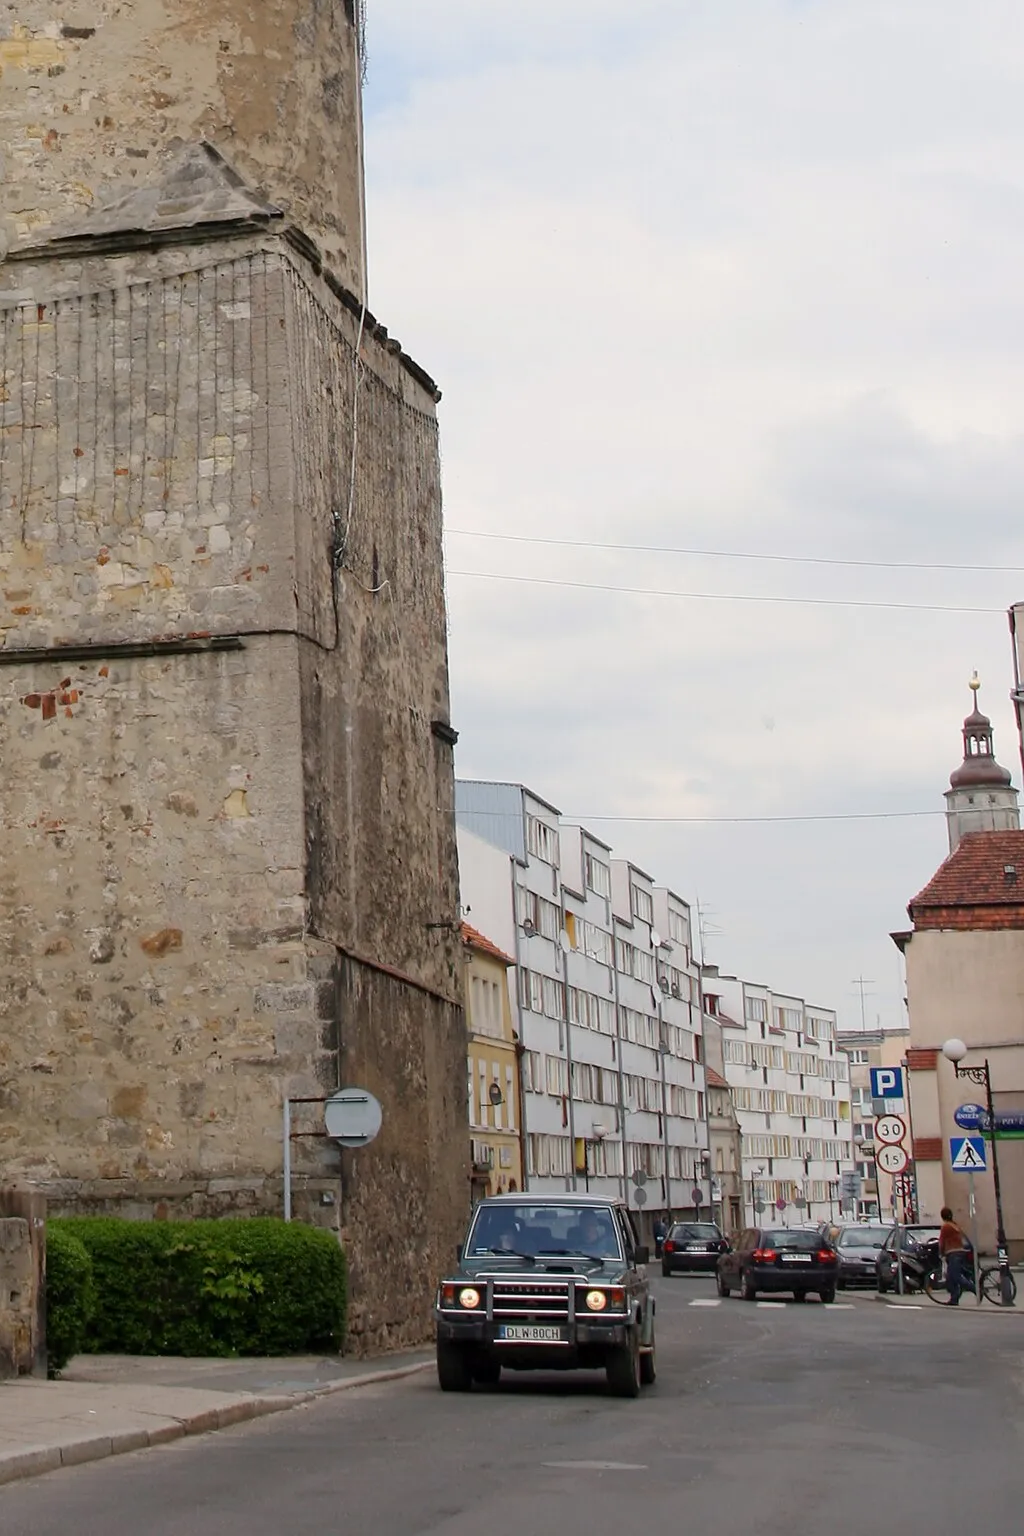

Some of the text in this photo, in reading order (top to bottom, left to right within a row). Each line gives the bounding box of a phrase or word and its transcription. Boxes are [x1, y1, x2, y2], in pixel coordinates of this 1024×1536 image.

[876, 1070, 896, 1096] P
[881, 1123, 901, 1136] 30
[506, 1327, 559, 1339] DLW 80CH
